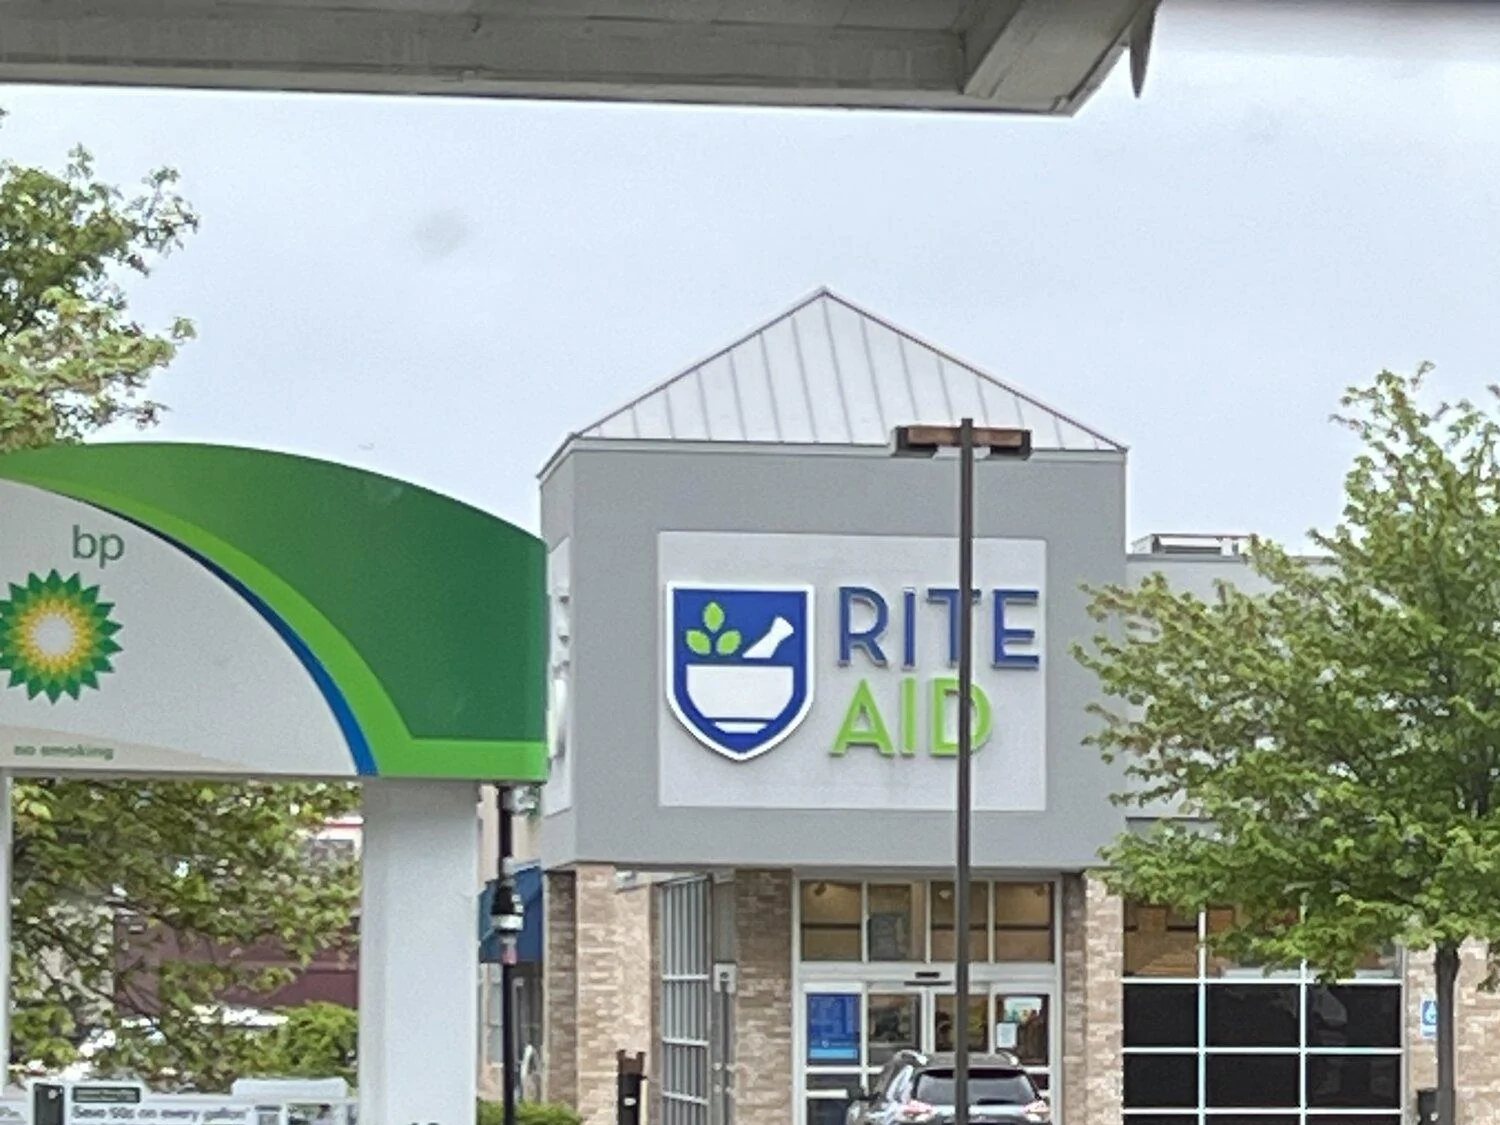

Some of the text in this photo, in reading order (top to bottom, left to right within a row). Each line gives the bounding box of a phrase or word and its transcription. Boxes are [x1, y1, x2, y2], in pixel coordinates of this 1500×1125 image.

[72, 524, 125, 569] bp
[838, 586, 1040, 670] RITE
[828, 676, 993, 758] AID
[14, 744, 114, 761] no smoking
